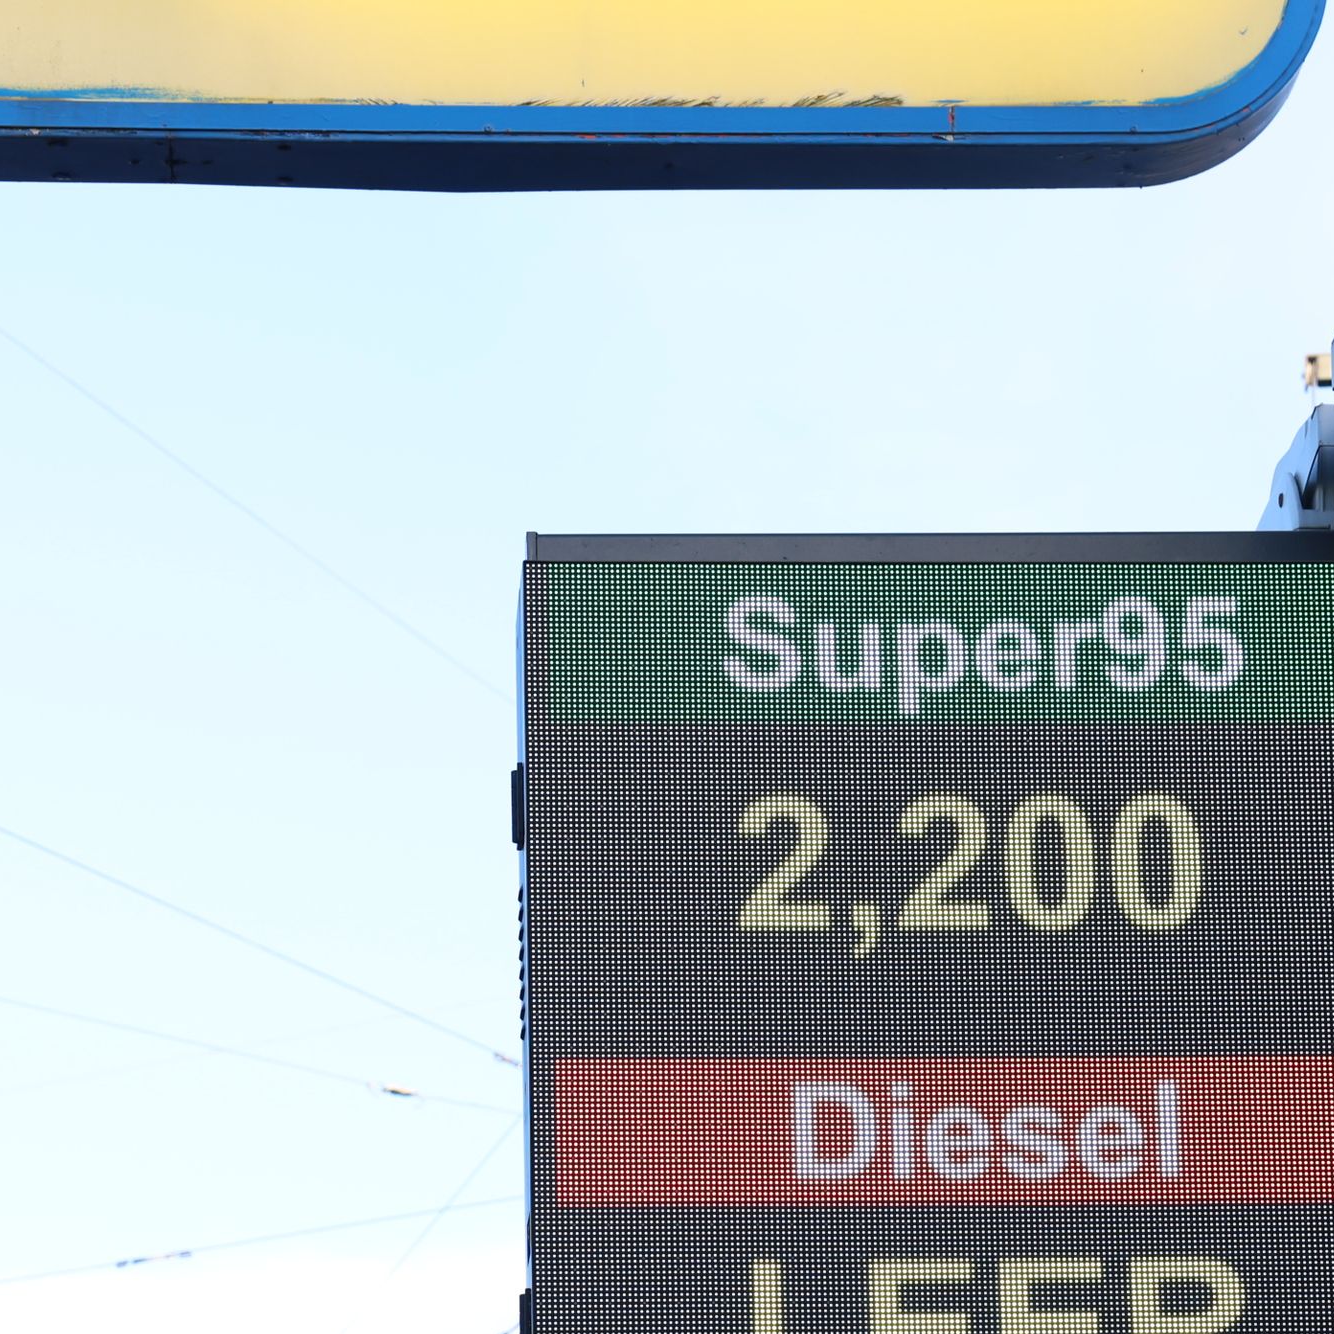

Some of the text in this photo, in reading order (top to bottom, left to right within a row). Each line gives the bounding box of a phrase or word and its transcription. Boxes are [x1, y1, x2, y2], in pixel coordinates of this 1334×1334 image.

[723, 595, 1245, 713] Super95
[738, 794, 1204, 956] 2,200
[790, 1080, 1183, 1182] Diesel
